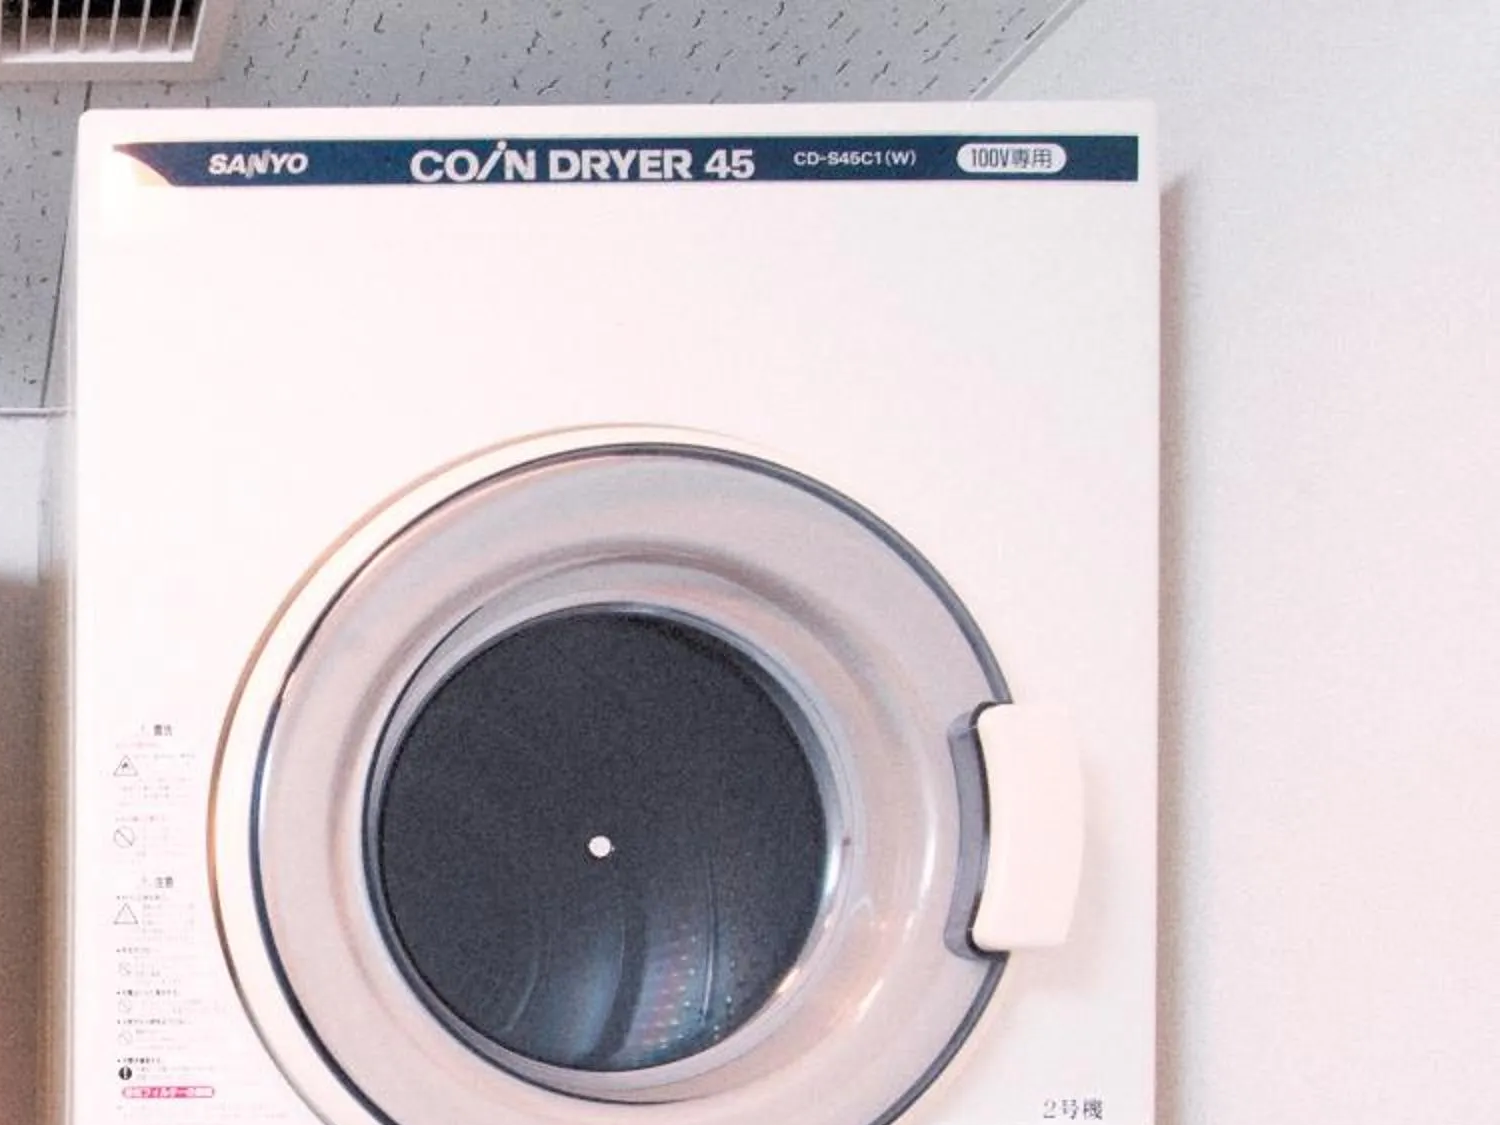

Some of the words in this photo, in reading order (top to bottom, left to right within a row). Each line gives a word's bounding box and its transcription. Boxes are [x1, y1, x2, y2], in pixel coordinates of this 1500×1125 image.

[208, 150, 309, 179] SANYO
[550, 150, 692, 181] DRYER
[704, 149, 755, 179] 45
[793, 150, 918, 171] CD-S45C1(W)
[971, 149, 1052, 170] 100V専用
[1043, 1099, 1104, 1122] 2号機
